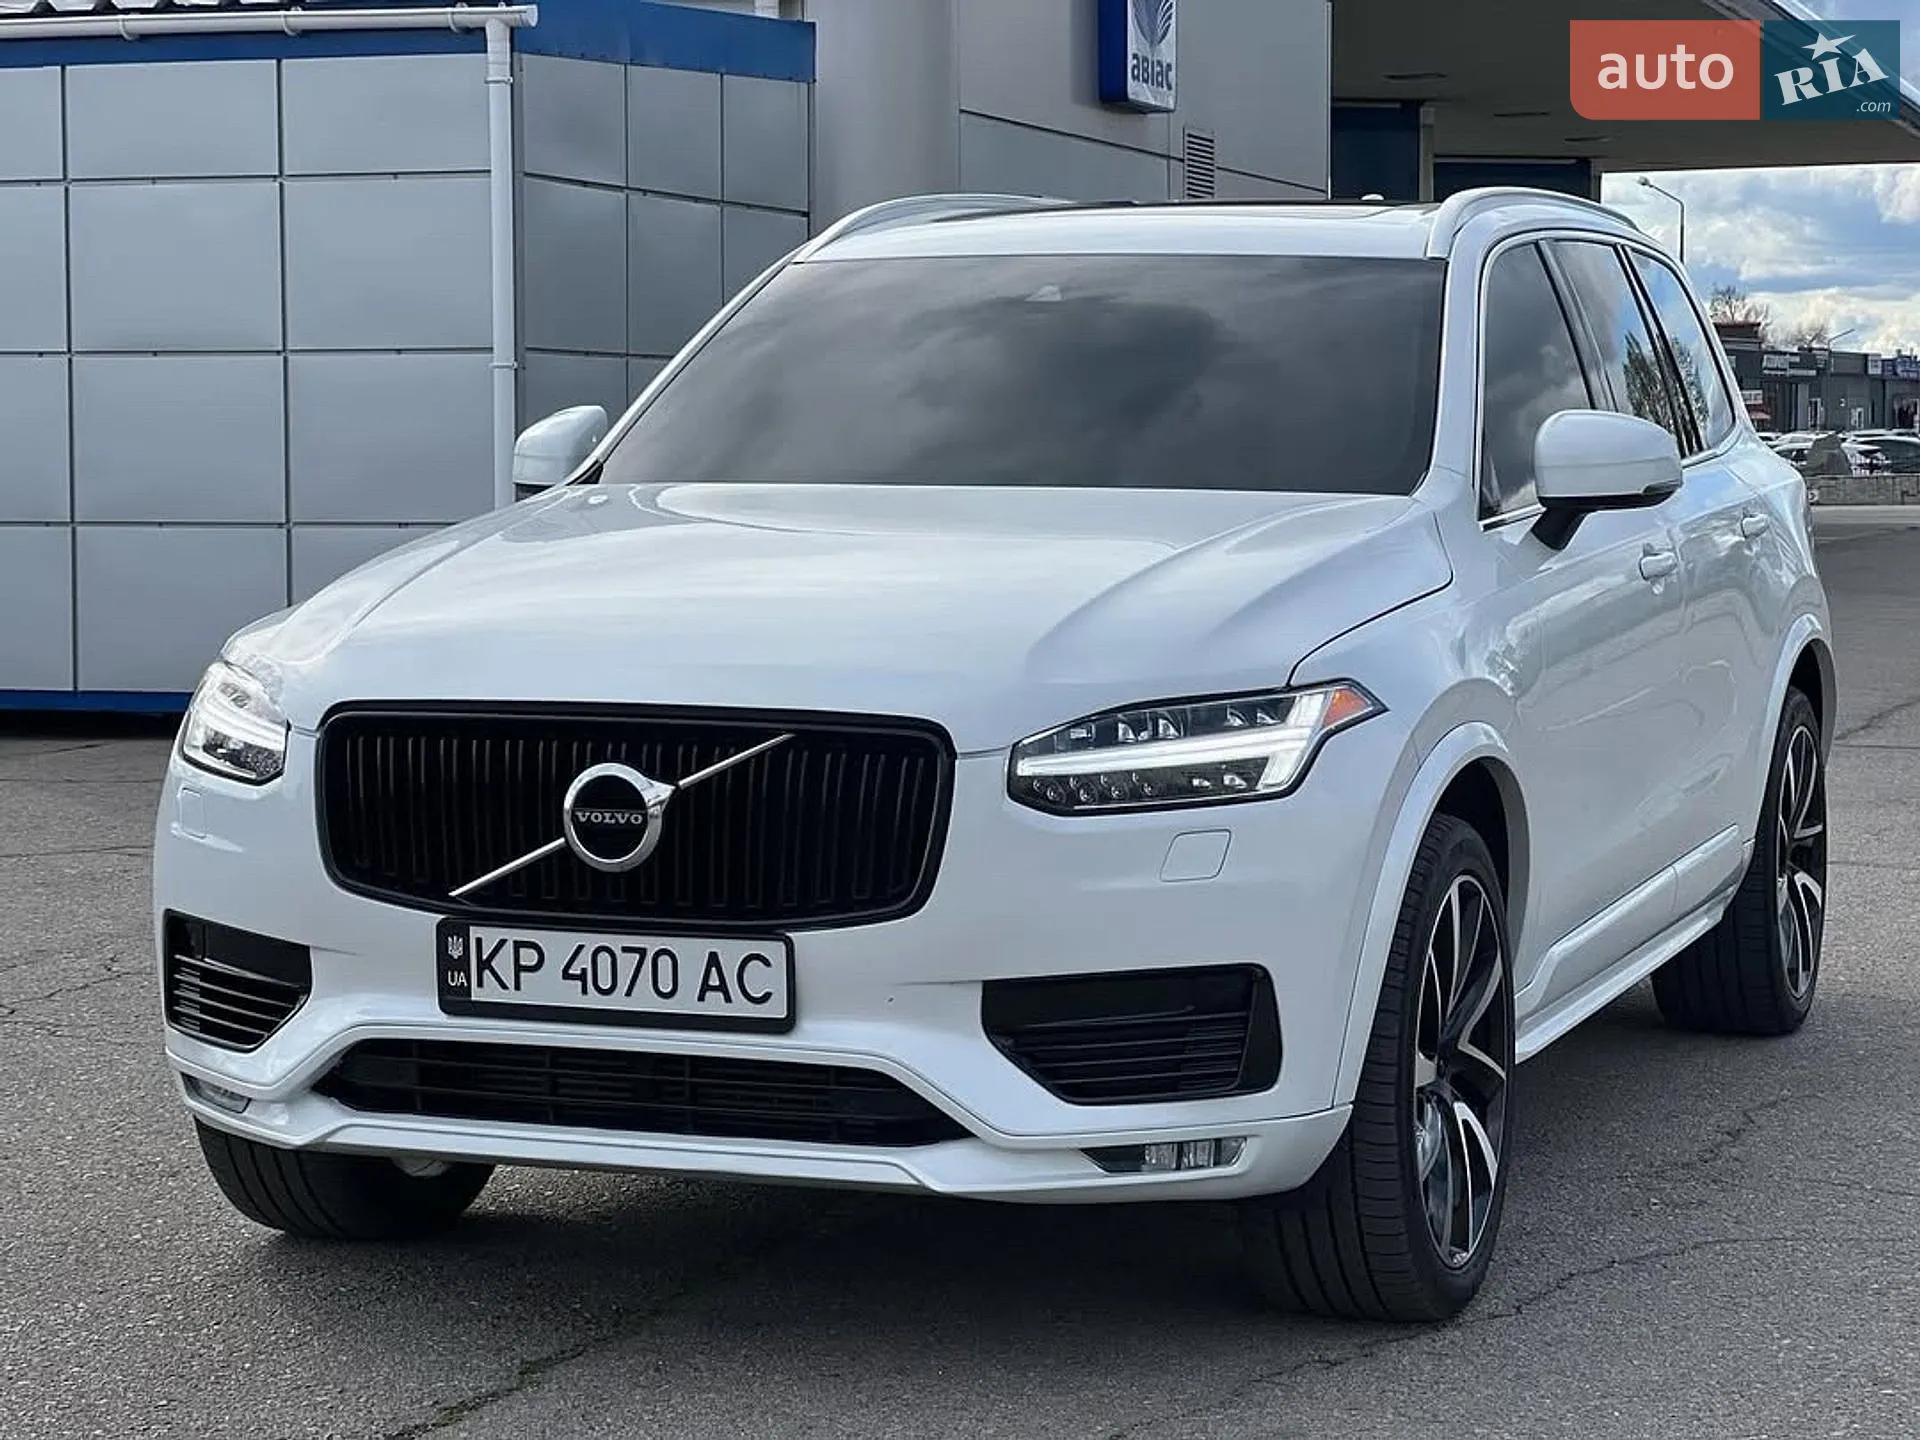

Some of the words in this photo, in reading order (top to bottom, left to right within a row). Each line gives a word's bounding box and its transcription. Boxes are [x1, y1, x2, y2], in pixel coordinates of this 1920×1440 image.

[575, 812, 643, 825] VOLVO
[448, 970, 467, 987] UA
[475, 936, 545, 992] KP
[561, 943, 679, 999] 4070
[697, 951, 773, 1004] AC
